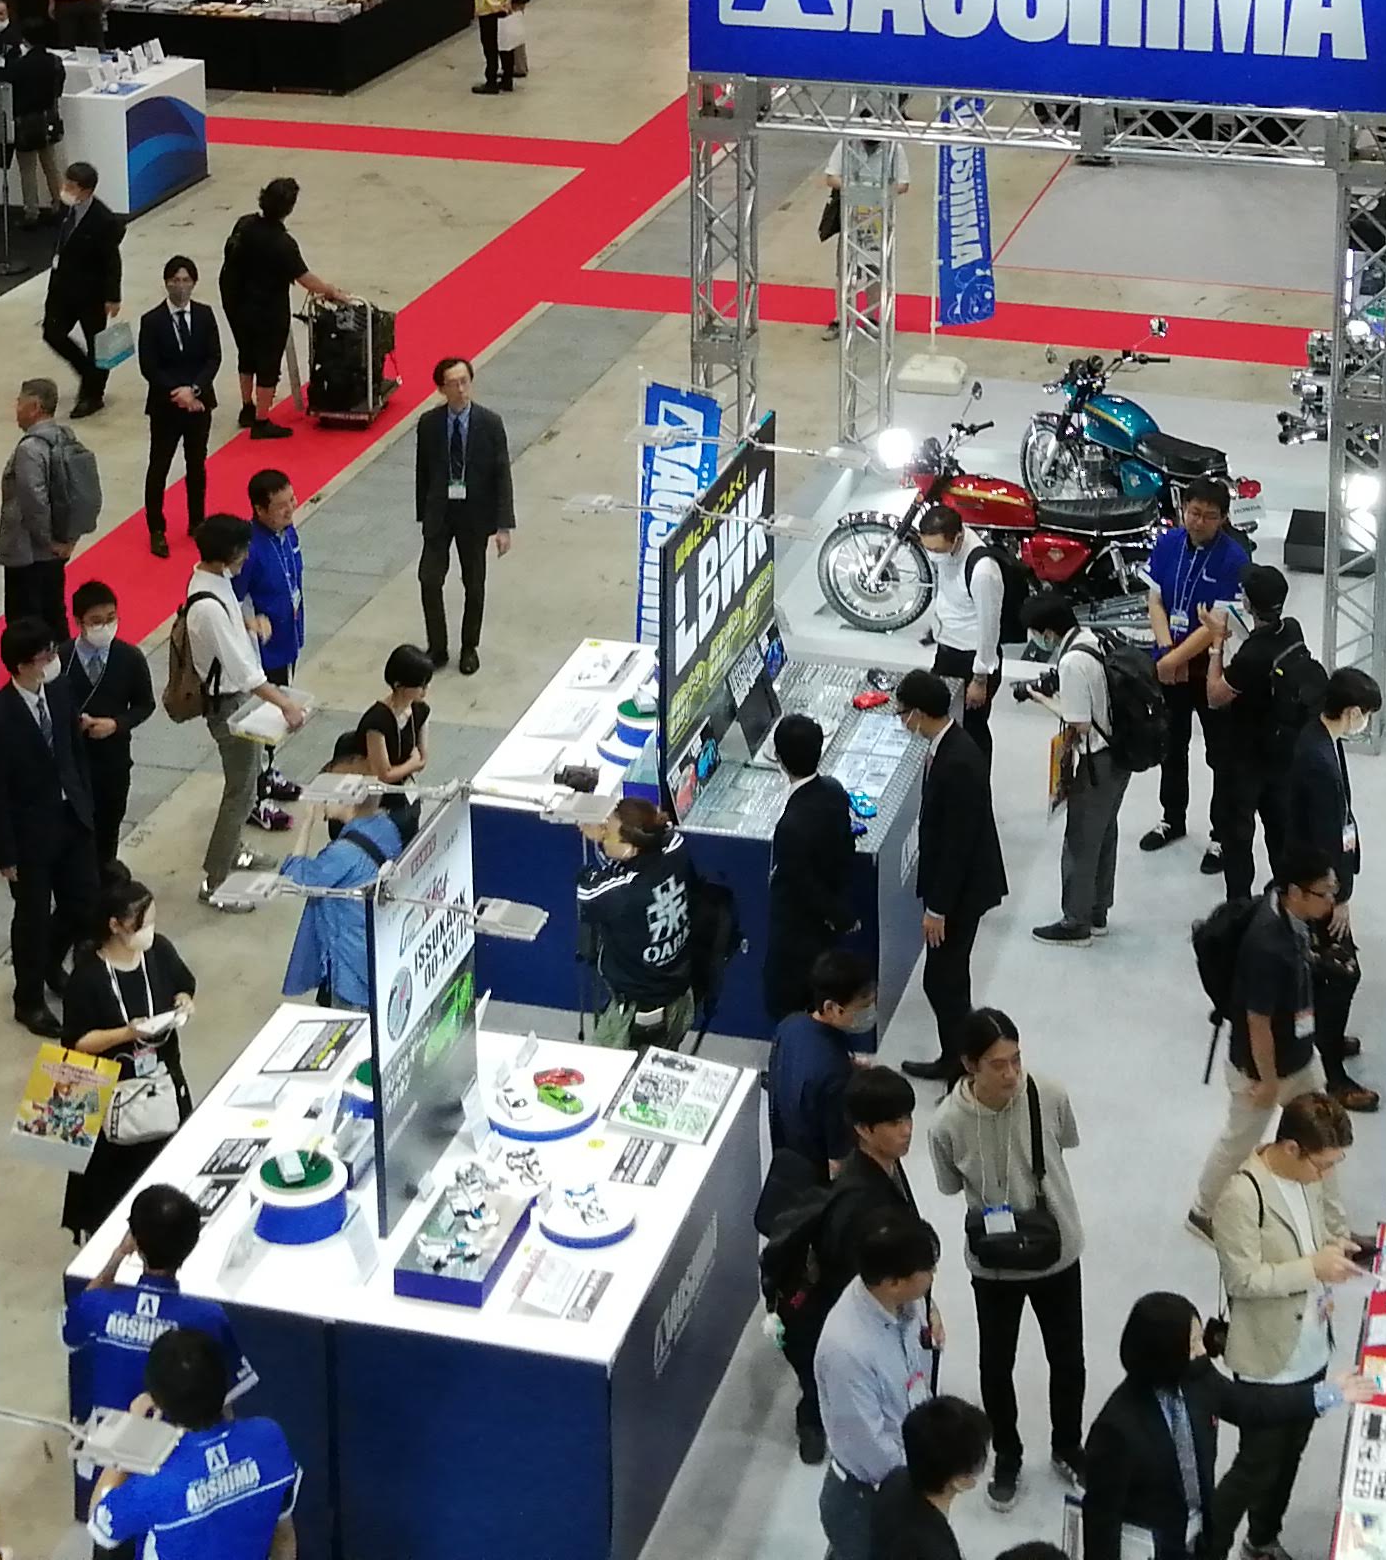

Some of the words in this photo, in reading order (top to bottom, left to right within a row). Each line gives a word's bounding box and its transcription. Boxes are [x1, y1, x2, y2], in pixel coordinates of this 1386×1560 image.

[675, 467, 768, 677] LBWK
[105, 1312, 180, 1343] AOSHI
[186, 1459, 261, 1514] AOSHIMA
